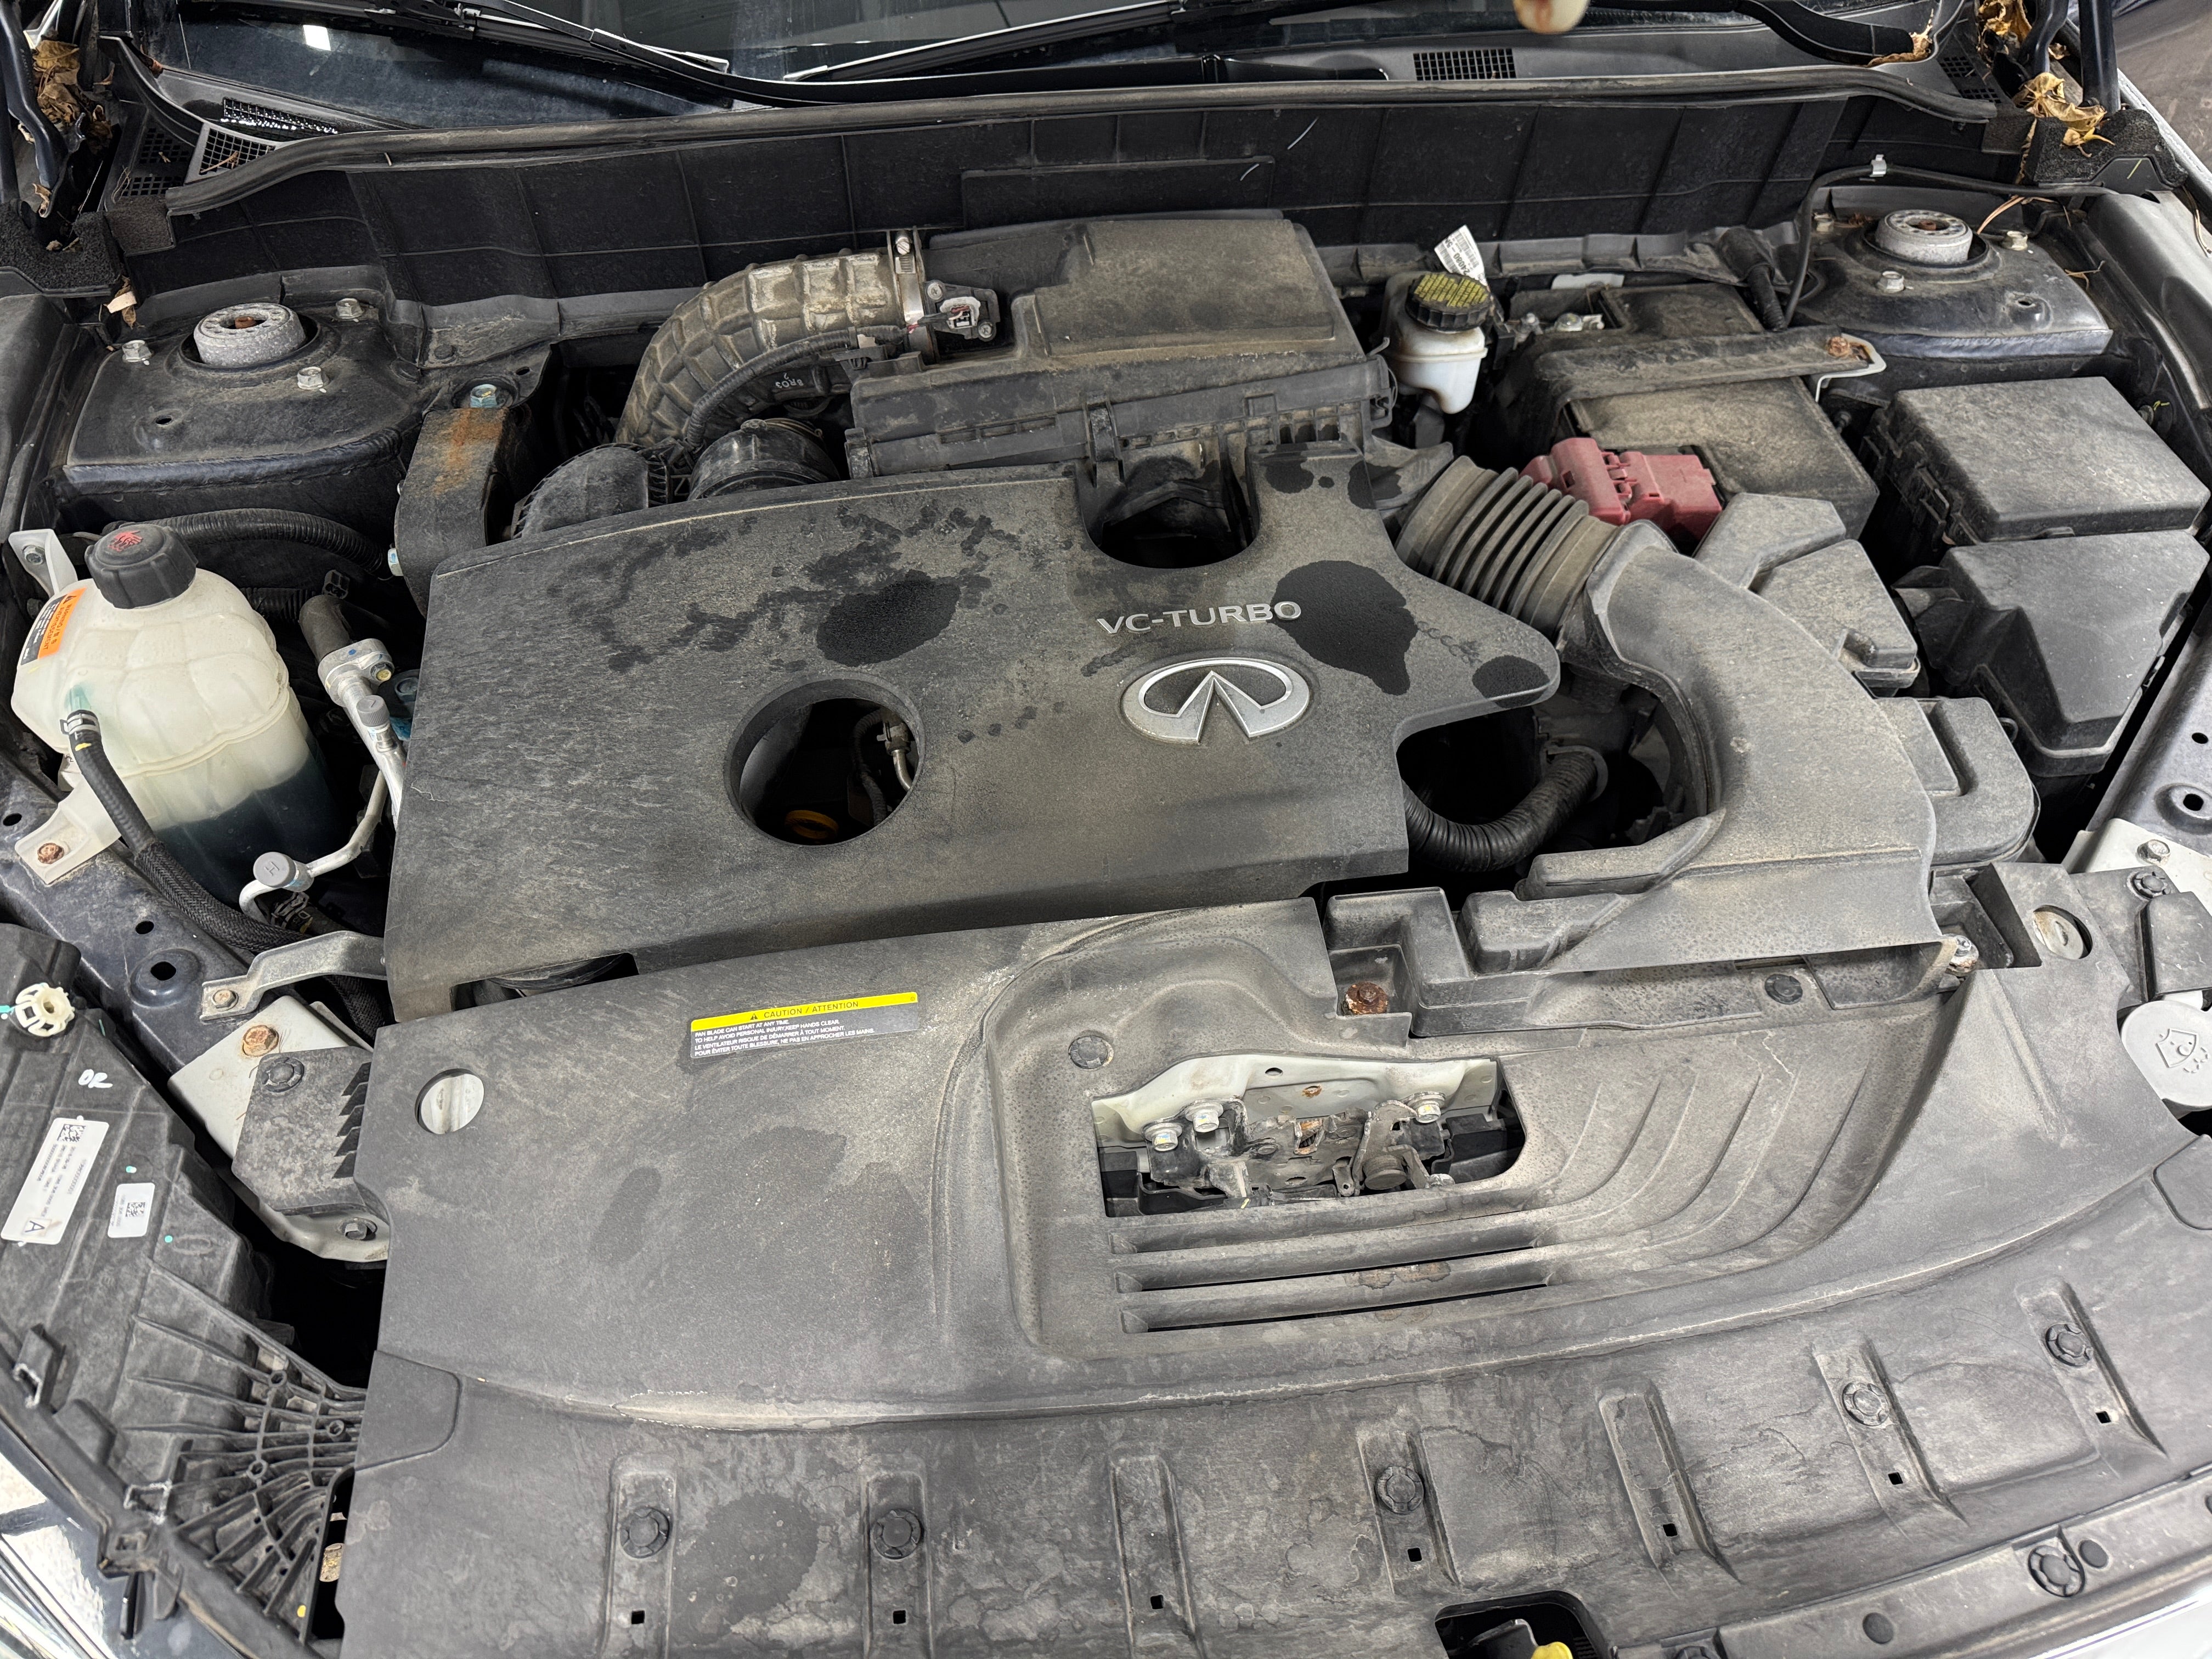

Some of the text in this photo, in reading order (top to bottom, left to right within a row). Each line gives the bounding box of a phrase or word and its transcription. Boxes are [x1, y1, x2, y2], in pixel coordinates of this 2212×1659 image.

[1097, 601, 1301, 634] VC-TURBO
[764, 1008, 802, 1018] CAUTION
[812, 1001, 858, 1013] ATTENTION
[702, 1039, 738, 1049] VENTILATEUR
[769, 1031, 799, 1039] DÉMARRER
[736, 1028, 765, 1037] PERSONAL
[749, 1040, 780, 1048] BLESSURE,
[810, 1031, 844, 1040] APPROCHER
[24, 1220, 45, 1233] A
